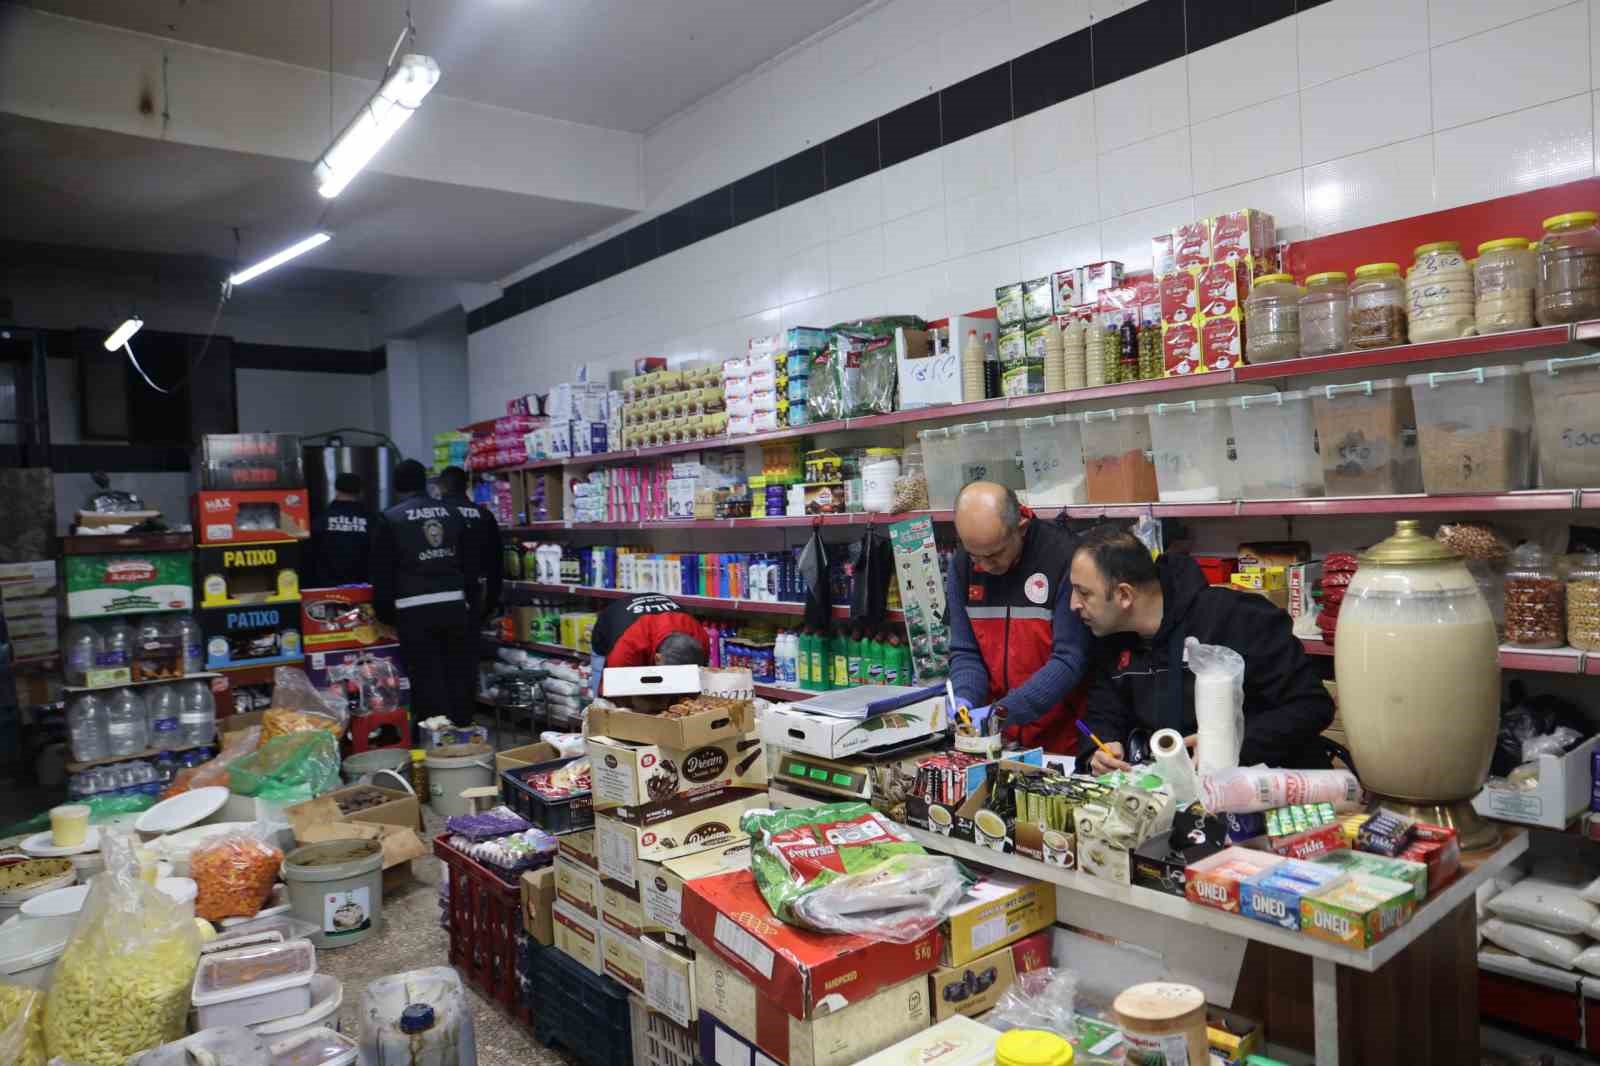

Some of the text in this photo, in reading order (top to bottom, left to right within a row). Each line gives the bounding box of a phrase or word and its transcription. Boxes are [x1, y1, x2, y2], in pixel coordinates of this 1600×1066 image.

[405, 507, 449, 520] ZABITA
[223, 549, 277, 567] PATIXO
[227, 610, 280, 628] PATIXO
[687, 755, 723, 773] Dream
[1196, 880, 1227, 903] ONEO
[1252, 893, 1285, 917] ONEO
[1314, 909, 1349, 935] ONEO
